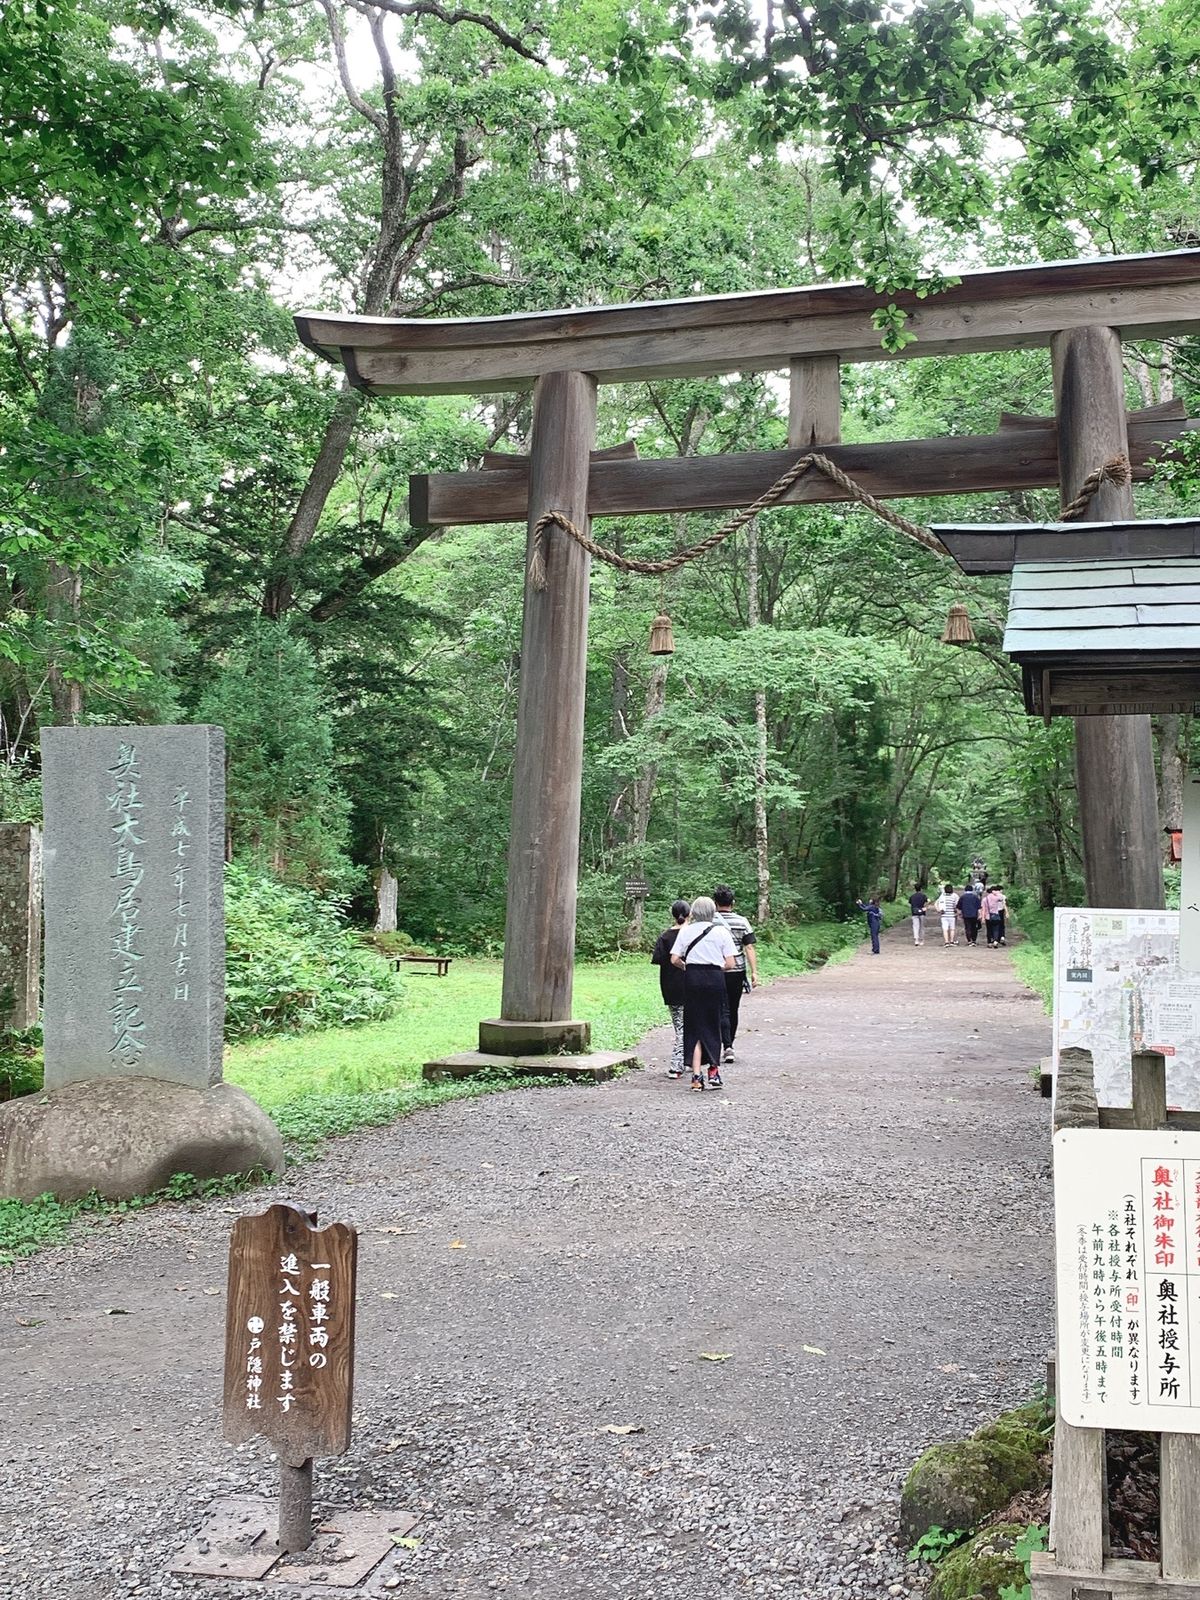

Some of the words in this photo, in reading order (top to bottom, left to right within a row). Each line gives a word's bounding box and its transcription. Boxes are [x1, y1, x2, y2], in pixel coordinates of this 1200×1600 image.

[107, 741, 147, 1068] 奥社大鳥居建立記念
[169, 785, 192, 1002] 平成七年七月吉日
[1107, 1209, 1123, 1359] ※各社授与所受付時間
[1152, 1165, 1175, 1268] 奥社御朱印
[246, 1338, 262, 1410] 戸隠神社
[276, 1253, 300, 1413] 進入を禁じます
[308, 1262, 331, 1369] 一般車両の
[1092, 1223, 1108, 1403] 午前九時から午後五時まで
[1157, 1278, 1180, 1400] 奥社授与所
